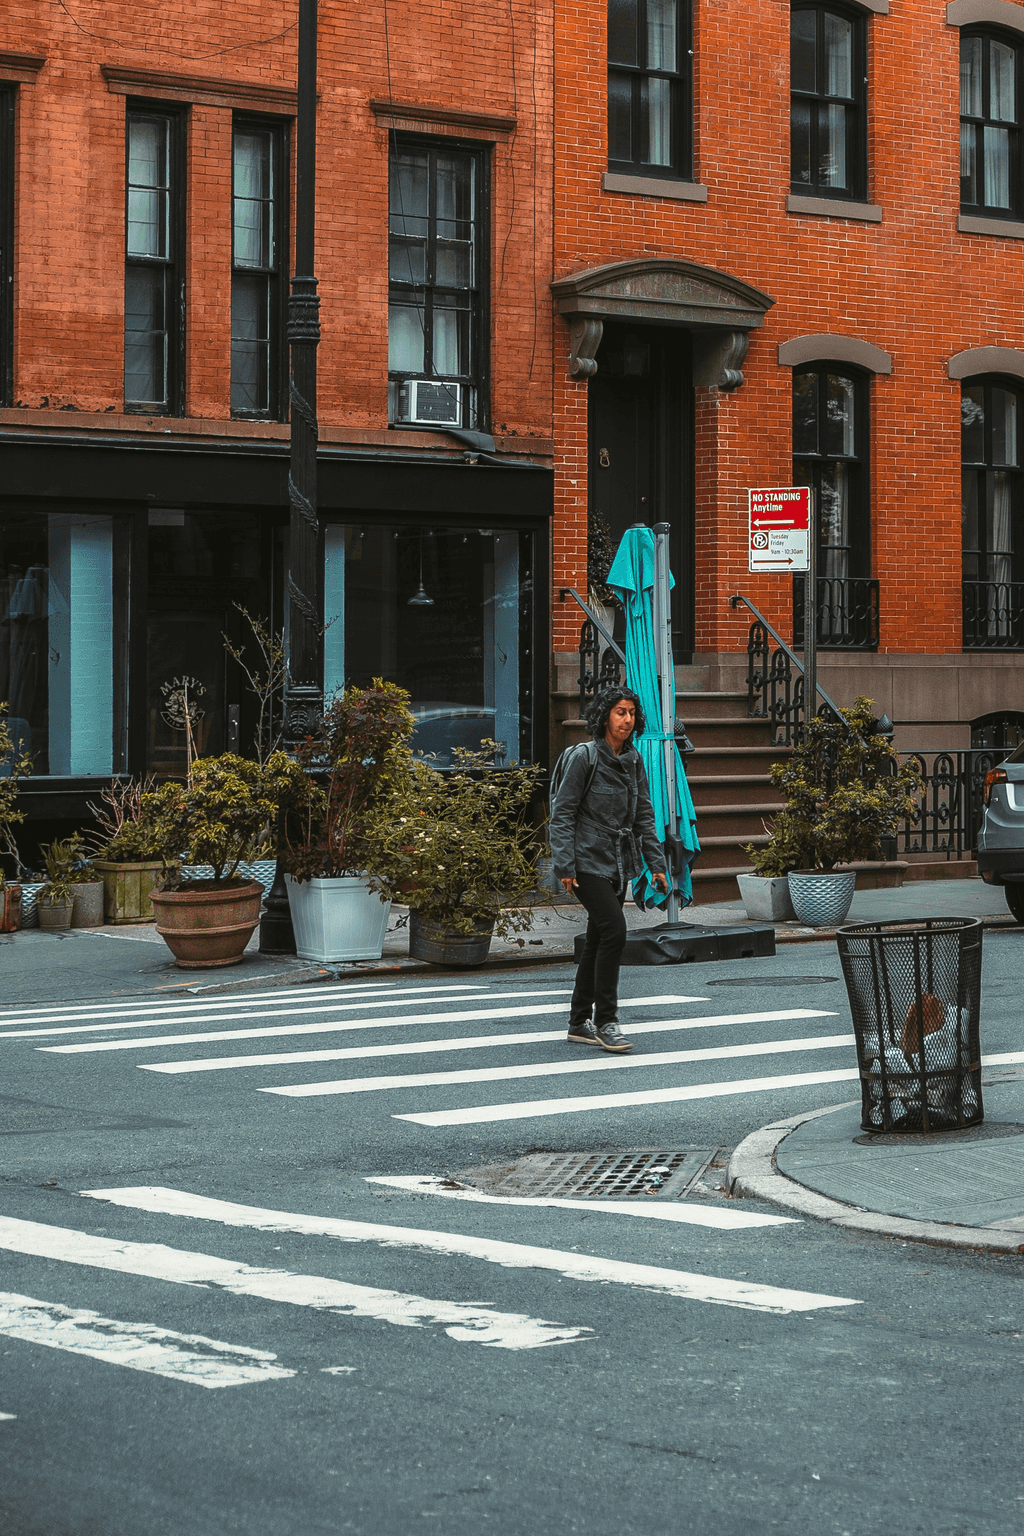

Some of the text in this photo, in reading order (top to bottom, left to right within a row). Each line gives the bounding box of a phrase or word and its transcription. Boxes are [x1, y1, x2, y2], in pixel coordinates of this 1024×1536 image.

[752, 492, 801, 502] NO STANDING
[752, 503, 783, 514] Anytime
[160, 675, 207, 696] MARY'S
